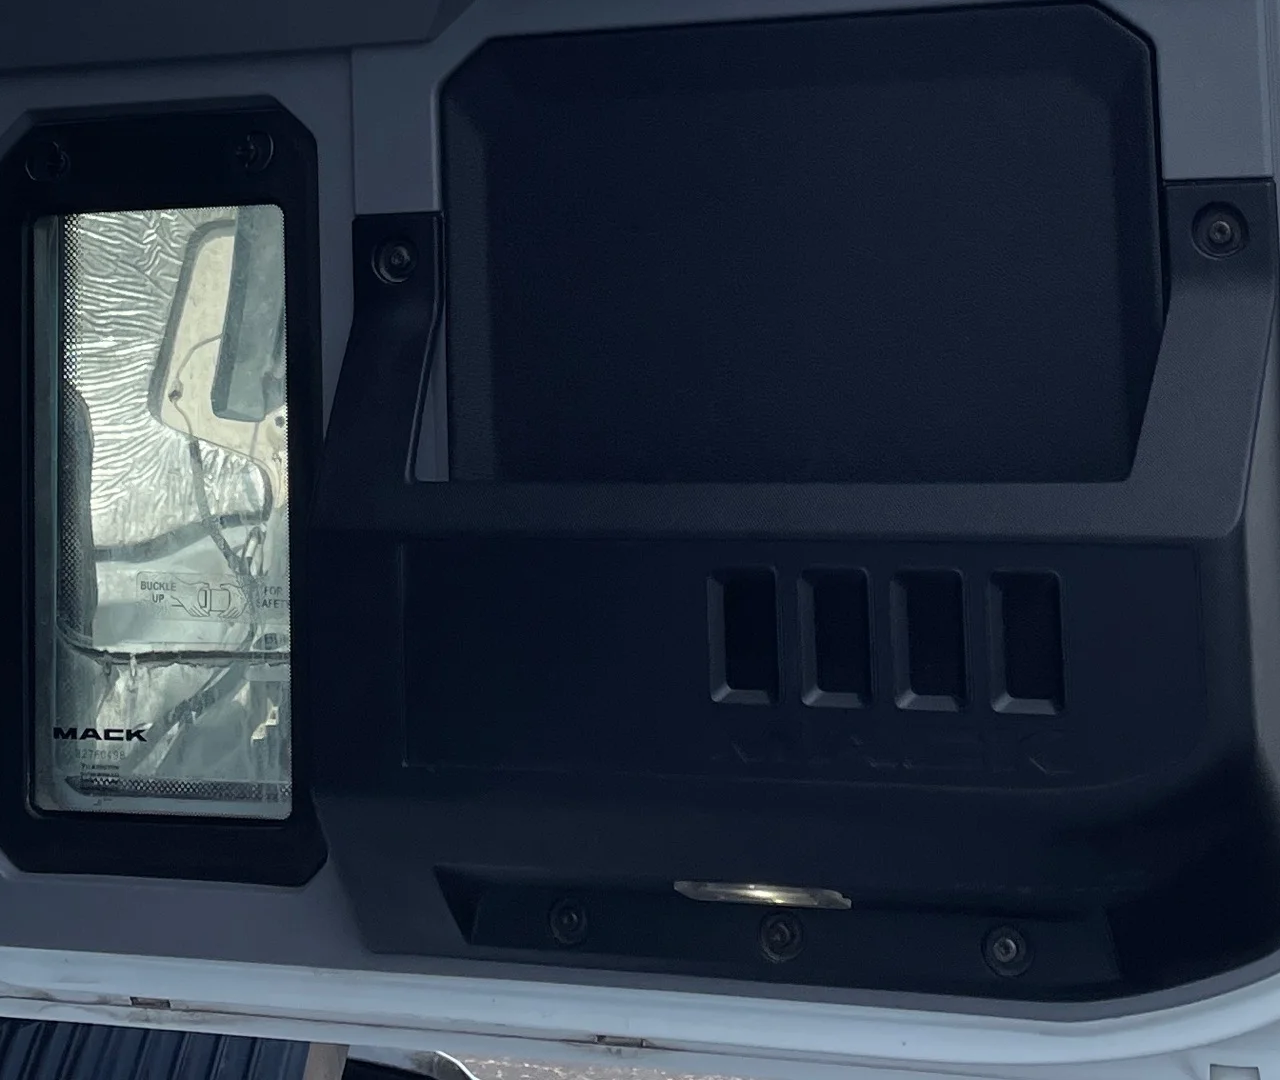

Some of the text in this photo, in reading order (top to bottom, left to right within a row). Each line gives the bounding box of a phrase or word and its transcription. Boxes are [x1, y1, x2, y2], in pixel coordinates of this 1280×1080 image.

[140, 580, 177, 592] BUCKLE
[151, 593, 165, 604] UP
[53, 726, 148, 743] MACK
